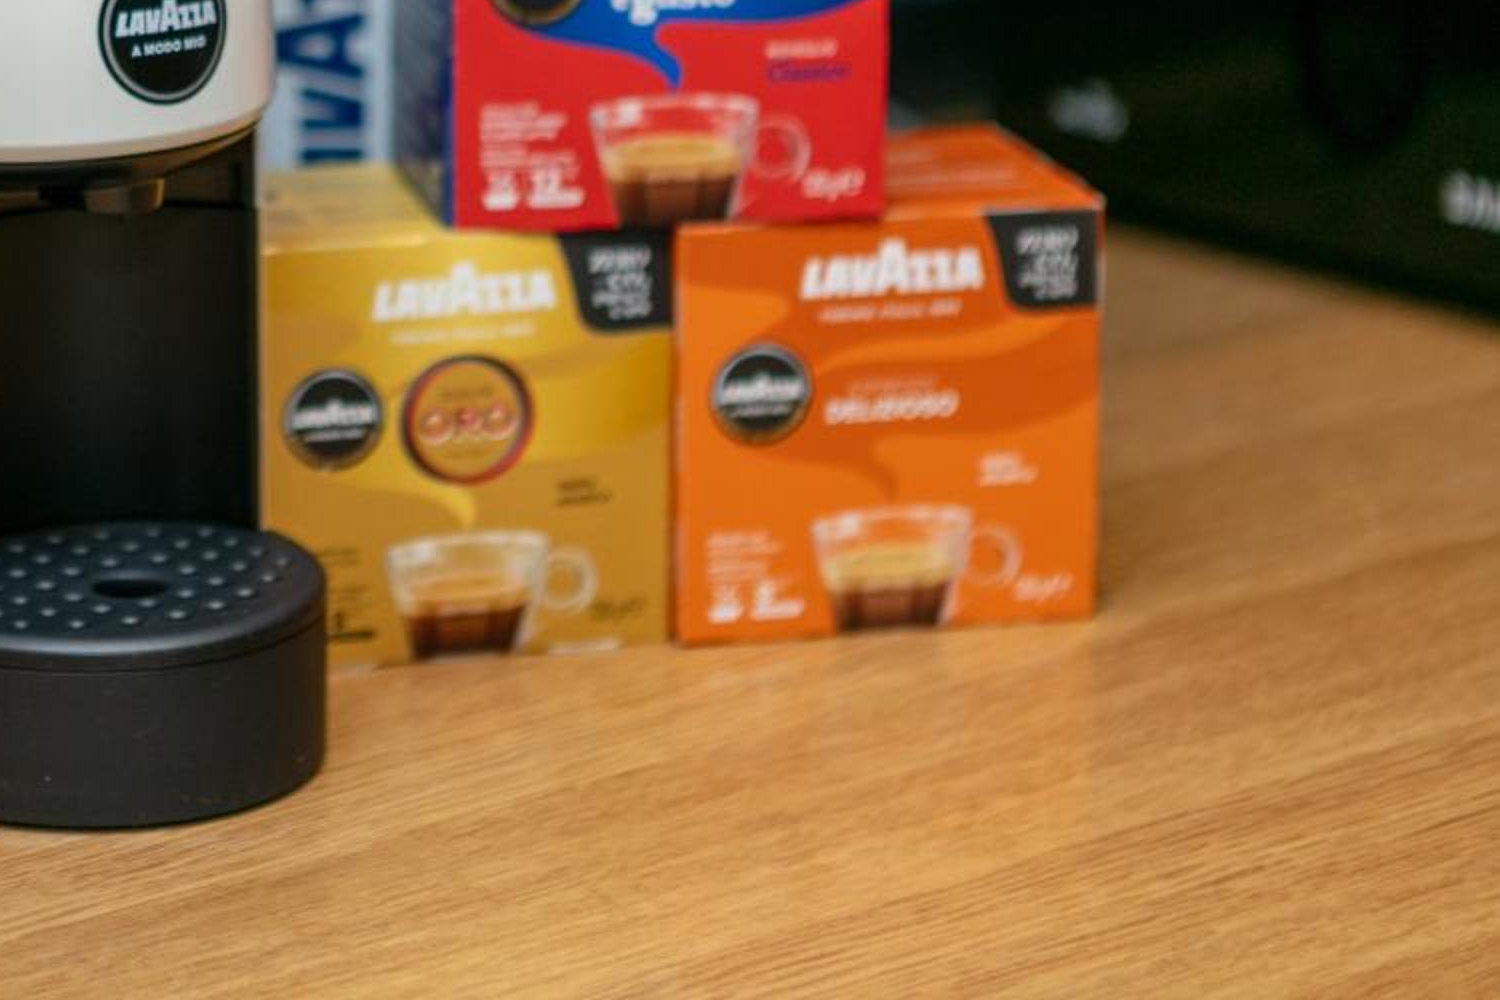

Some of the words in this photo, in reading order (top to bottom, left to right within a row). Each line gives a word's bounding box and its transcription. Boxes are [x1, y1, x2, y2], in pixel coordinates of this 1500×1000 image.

[132, 45, 143, 58] A
[371, 260, 557, 323] LAVAZZA
[801, 238, 984, 301] LAVAZZA
